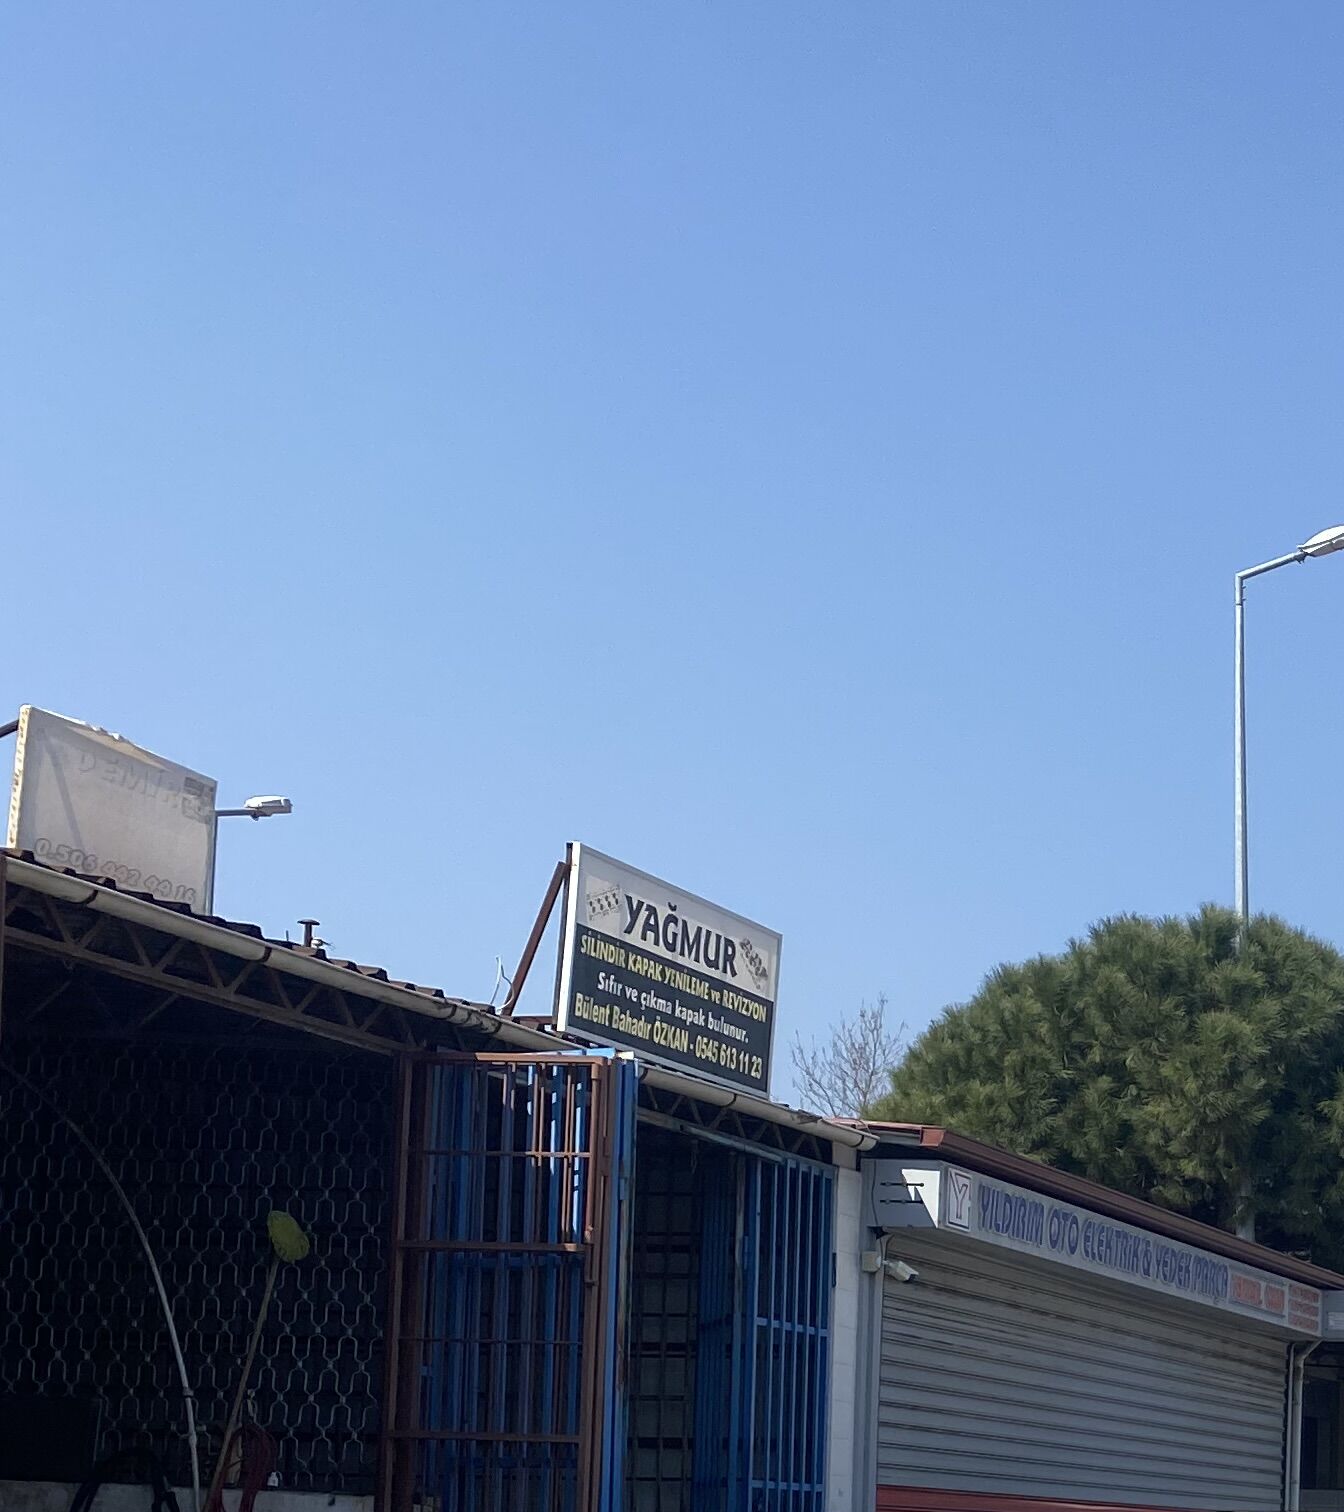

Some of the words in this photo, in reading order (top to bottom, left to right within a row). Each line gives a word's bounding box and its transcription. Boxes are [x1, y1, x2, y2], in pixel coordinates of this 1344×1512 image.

[624, 893, 738, 978] YAĞMUR
[624, 985, 638, 1002] ve
[674, 999, 705, 1027] kapak
[627, 955, 663, 982] KAPAK
[710, 988, 721, 1002] ve
[574, 993, 611, 1027] Bülent
[611, 1005, 651, 1041] Bahadır
[653, 1016, 689, 1053] ÖZKAN
[695, 1035, 719, 1064] 0545
[719, 1044, 737, 1069] 613
[739, 1052, 750, 1075] 11
[751, 1055, 763, 1079] 23
[978, 1183, 1045, 1247] YILDIRIM
[1049, 1208, 1080, 1256] OTO
[1154, 1240, 1192, 1289] YEDEK
